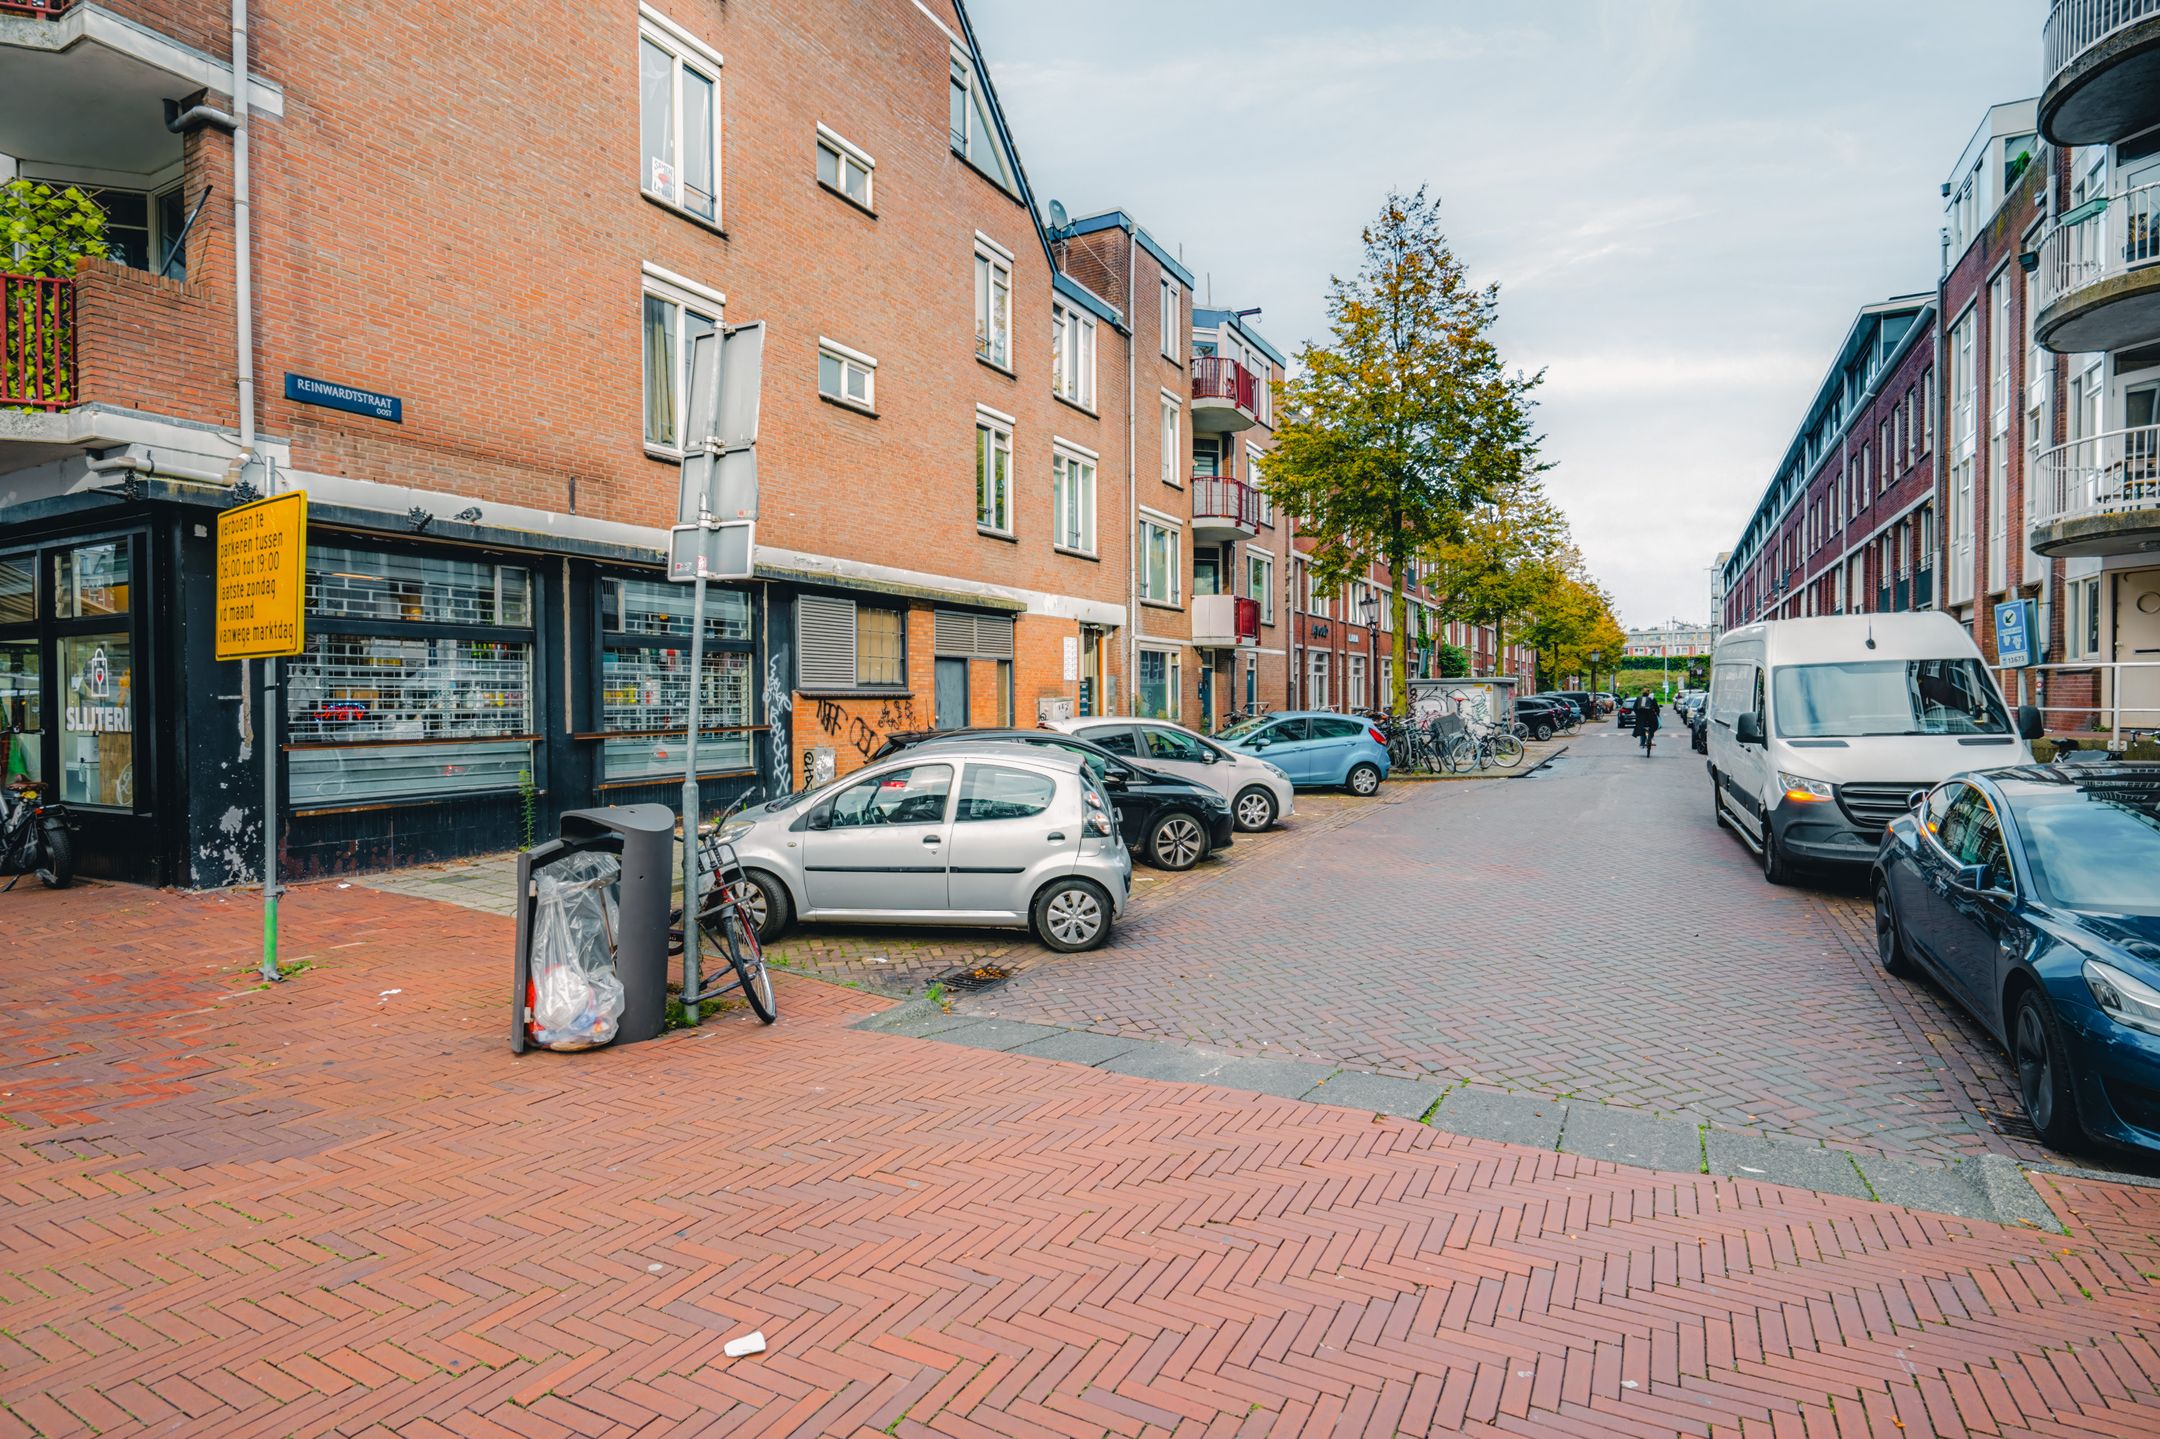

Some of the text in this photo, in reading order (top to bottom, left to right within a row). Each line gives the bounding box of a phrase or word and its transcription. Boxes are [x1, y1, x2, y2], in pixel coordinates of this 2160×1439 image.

[297, 378, 393, 409] REINWARDTSTRAAT
[376, 407, 393, 417] OOST
[220, 510, 265, 537] verboden te
[220, 531, 283, 559] parkeren tussen
[220, 551, 280, 579] 06:00 tot 19:00
[219, 577, 276, 601] laatste zondag
[219, 600, 255, 622] vd maand
[219, 619, 294, 648] vanwege marktdag
[66, 706, 132, 732] SLIJTERI
